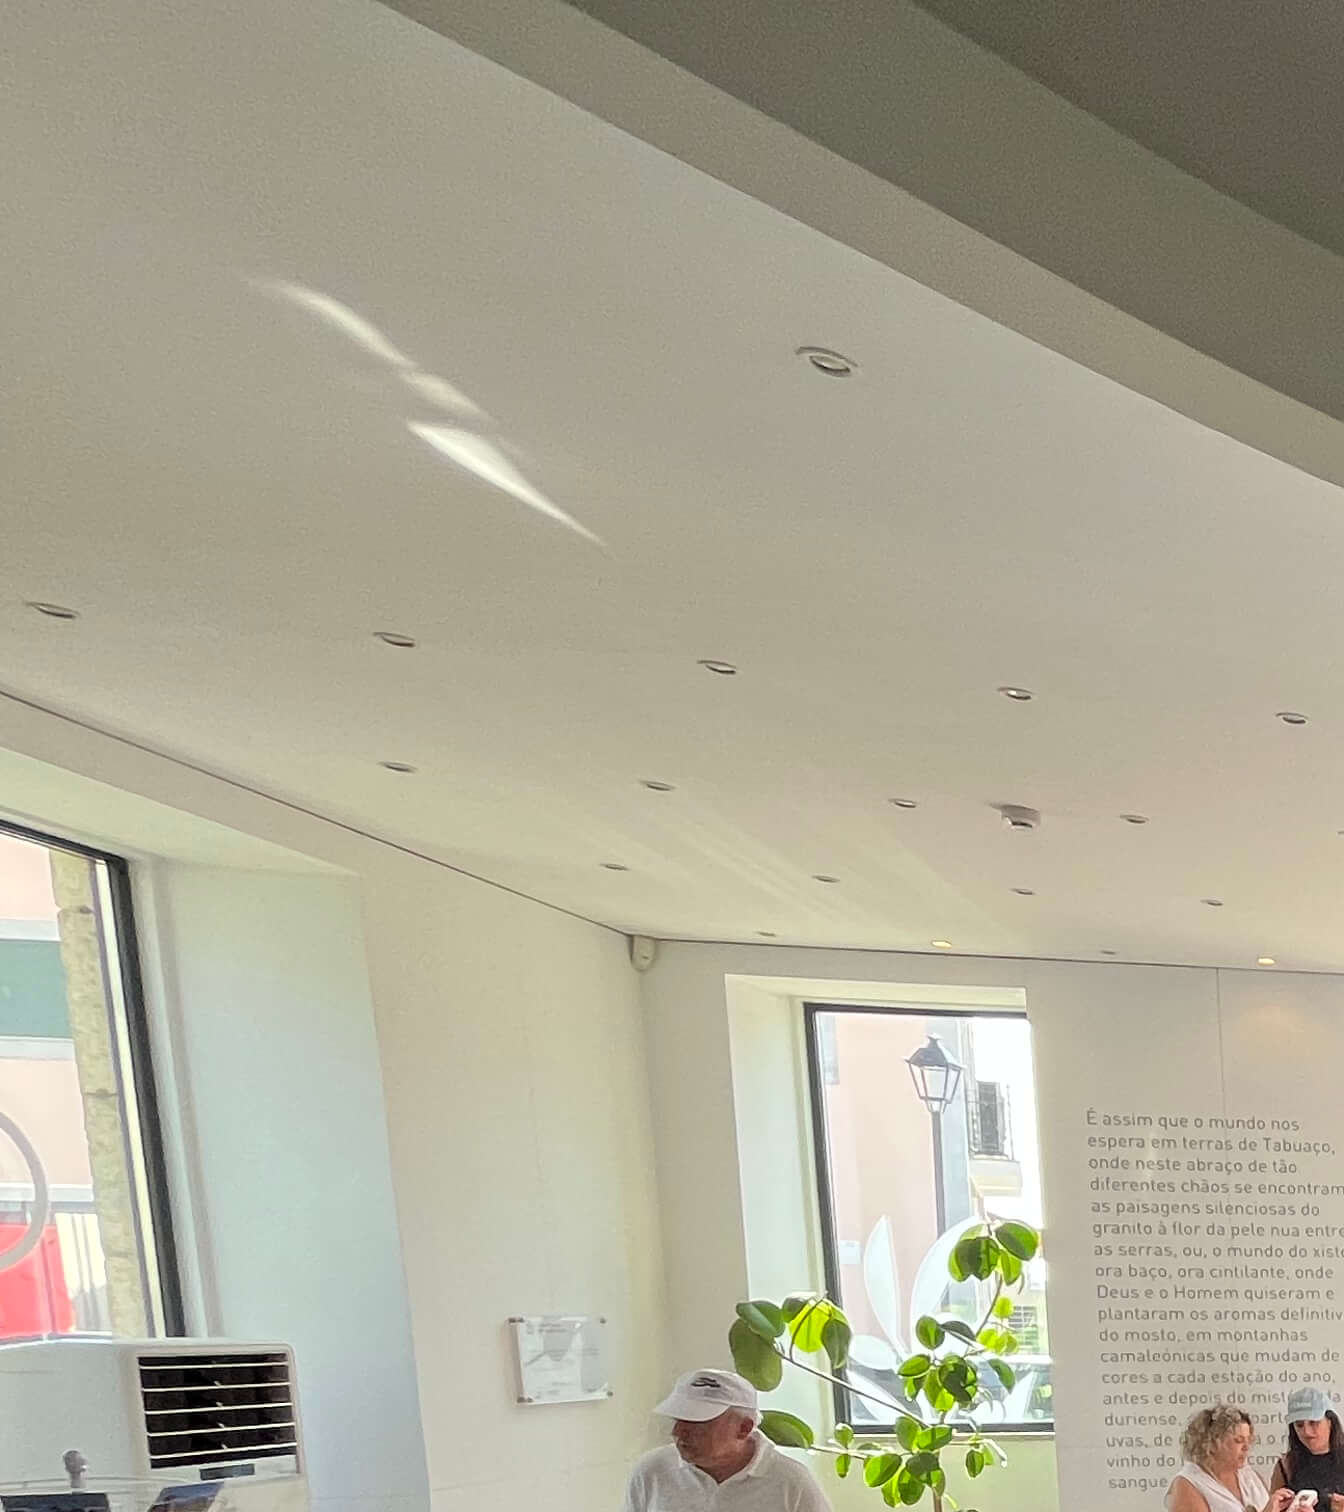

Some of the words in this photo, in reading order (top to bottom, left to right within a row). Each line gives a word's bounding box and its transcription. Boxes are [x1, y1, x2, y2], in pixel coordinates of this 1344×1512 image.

[1087, 1108, 1097, 1126] É
[1103, 1114, 1152, 1127] assim
[1158, 1117, 1188, 1131] que
[1194, 1118, 1203, 1128] o
[1209, 1116, 1265, 1130] mundo
[1271, 1120, 1299, 1131] nos
[1088, 1136, 1145, 1151] espera
[1151, 1137, 1176, 1149] em
[1183, 1137, 1232, 1151] terras
[1239, 1137, 1257, 1151] de
[1264, 1138, 1336, 1156] Tabuaço,
[1089, 1157, 1129, 1170] onde
[1136, 1159, 1180, 1171] neste
[1187, 1160, 1243, 1176] abraço
[1248, 1160, 1267, 1173] de
[1273, 1160, 1297, 1173] tão
[1090, 1177, 1175, 1192] diferentes
[1181, 1179, 1229, 1194] chãos
[1235, 1183, 1252, 1193] se
[1091, 1202, 1111, 1213] as
[1117, 1201, 1200, 1217] paisagens
[1206, 1202, 1296, 1216] silenciosas
[1301, 1204, 1319, 1217] do
[1093, 1221, 1152, 1237] granito
[1172, 1221, 1200, 1235] flor
[1206, 1222, 1225, 1236] da
[1232, 1223, 1264, 1240] pele
[1271, 1226, 1300, 1237] nua
[1094, 1245, 1113, 1256] as
[1118, 1246, 1177, 1259] serras,
[1183, 1246, 1207, 1259] ou,
[1213, 1247, 1221, 1257] o
[1228, 1245, 1284, 1257] mundo
[1289, 1245, 1308, 1258] do
[1096, 1266, 1122, 1277] ora
[1178, 1267, 1204, 1278] ora
[1295, 1267, 1333, 1279] onde
[1097, 1285, 1139, 1299] Deus
[1145, 1288, 1153, 1298] e
[1160, 1288, 1168, 1299] o
[1174, 1285, 1239, 1299] Homem
[1244, 1288, 1320, 1301] quiseram
[1326, 1289, 1334, 1299] e
[1099, 1308, 1184, 1324] plantaram
[1190, 1310, 1208, 1321] os
[1214, 1310, 1275, 1321] aromas
[1100, 1329, 1118, 1342] do
[1125, 1330, 1181, 1343] mosto,
[1187, 1330, 1211, 1341] em
[1217, 1329, 1307, 1342] montanhas
[1101, 1349, 1215, 1363] camaleónicas
[1220, 1351, 1248, 1365] que
[1255, 1349, 1315, 1362] mudam
[1322, 1349, 1339, 1362] de
[1102, 1373, 1149, 1384] cores
[1153, 1373, 1161, 1383] a
[1168, 1371, 1205, 1384] cada
[1211, 1370, 1273, 1387] estação
[1279, 1370, 1297, 1383] do
[1303, 1373, 1335, 1385] ano,
[1104, 1393, 1148, 1405] antes
[1154, 1395, 1163, 1405] e
[1169, 1391, 1220, 1408] depois
[1227, 1391, 1246, 1404] do
[1106, 1435, 1148, 1447] uvas,
[1154, 1434, 1172, 1446] de
[1107, 1454, 1150, 1467] vinho
[1156, 1454, 1175, 1466] do
[1109, 1477, 1168, 1493] sangue
